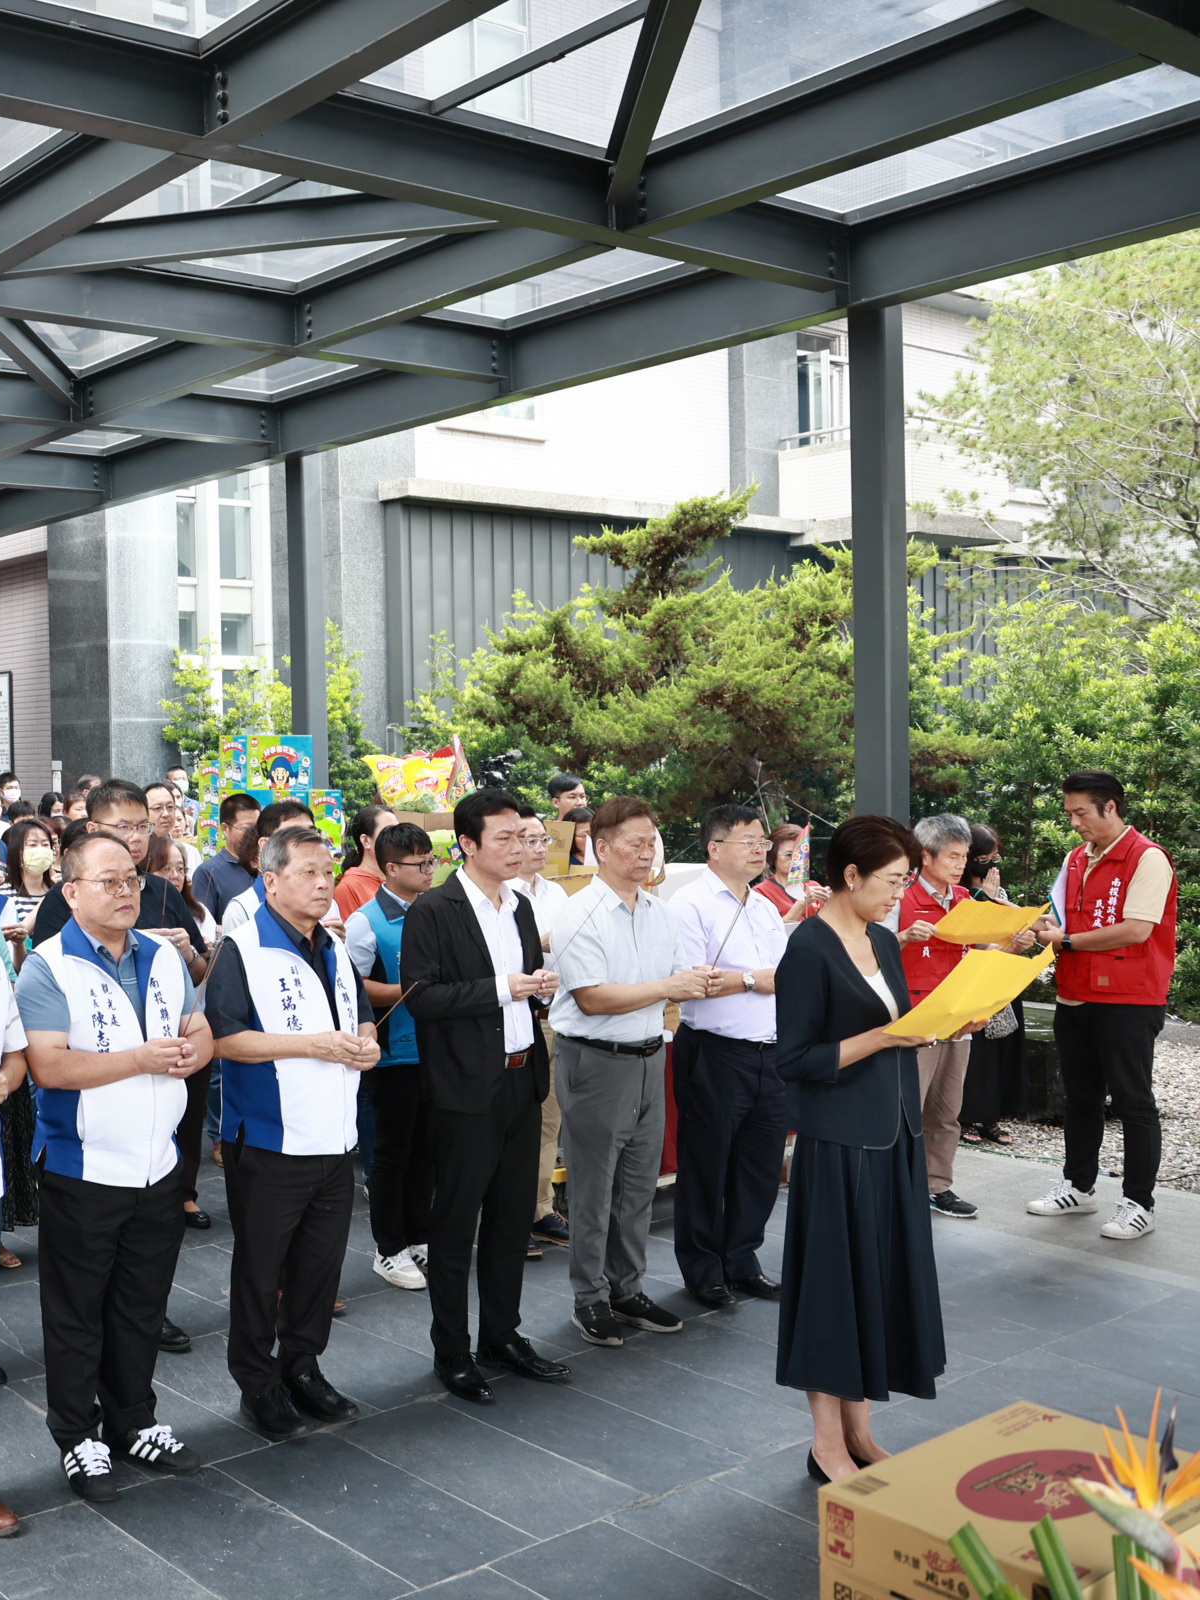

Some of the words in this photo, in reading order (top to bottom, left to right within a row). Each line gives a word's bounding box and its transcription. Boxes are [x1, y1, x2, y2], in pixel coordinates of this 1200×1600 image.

[1092, 899, 1104, 927] 民政處
[1106, 877, 1121, 924] 南投縣政府
[278, 978, 303, 1032] 王瑞德
